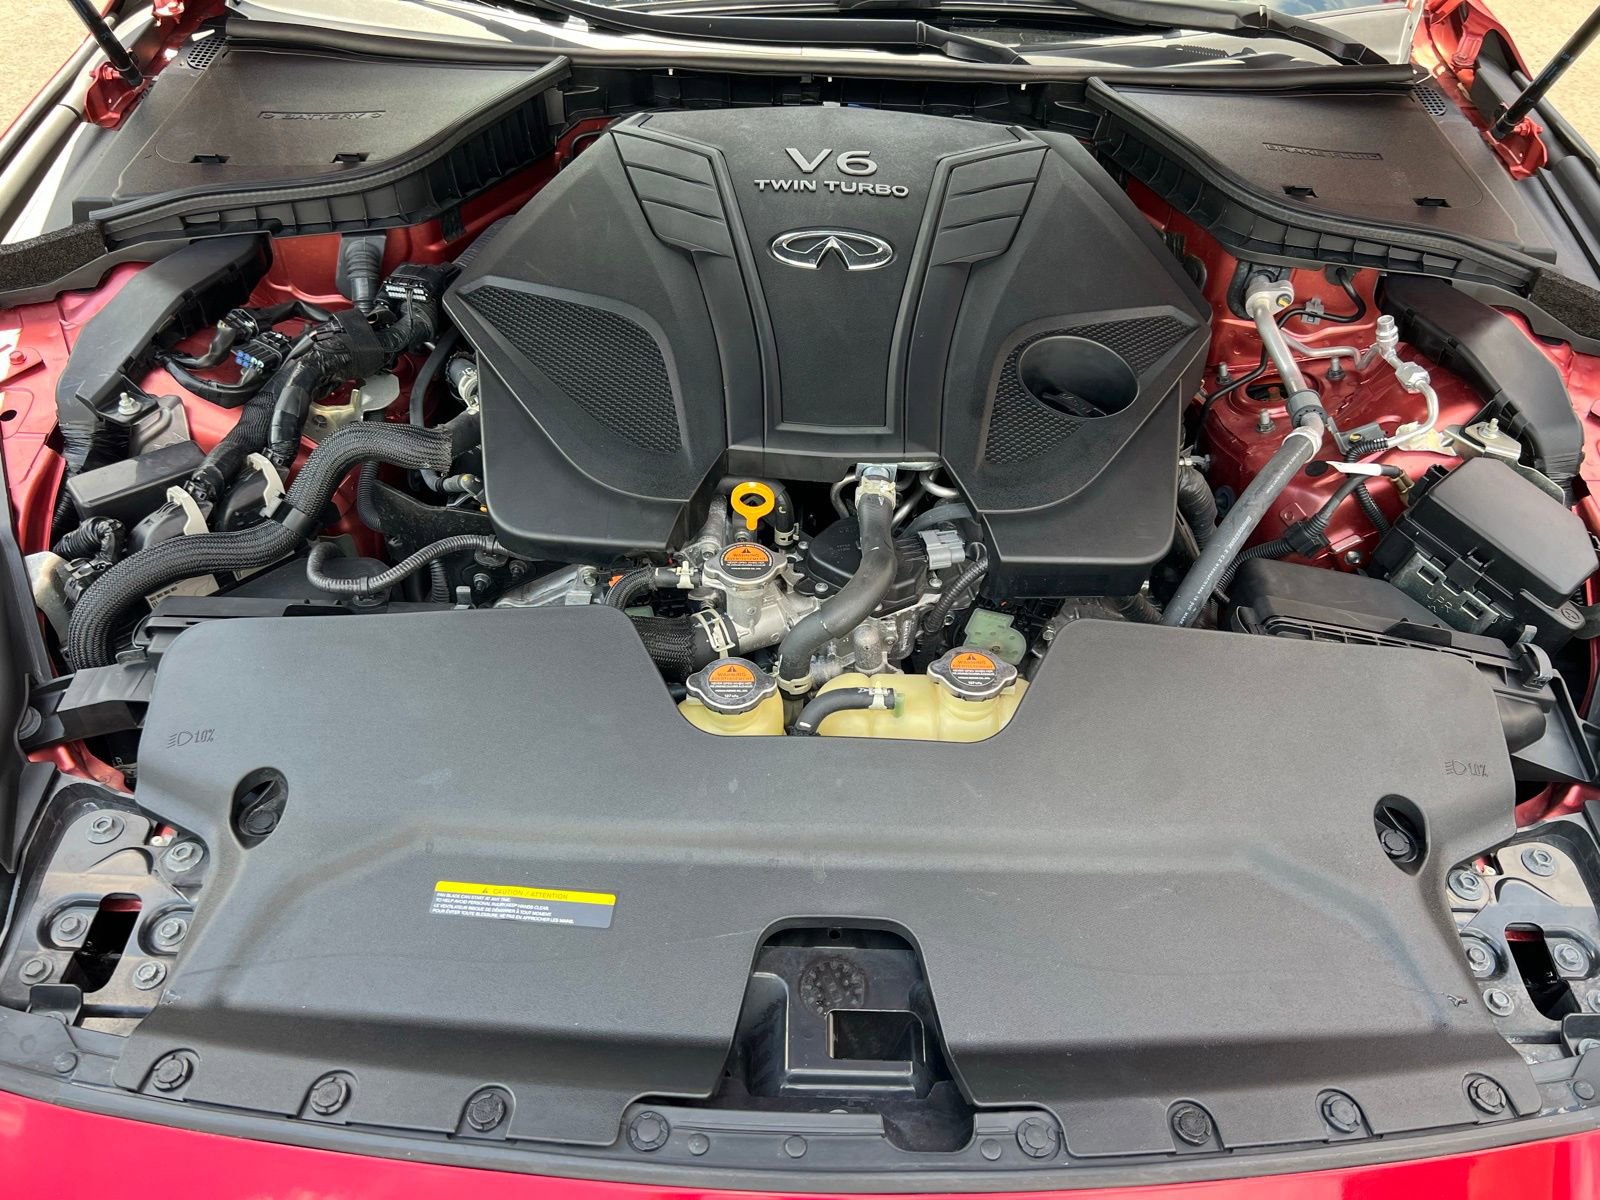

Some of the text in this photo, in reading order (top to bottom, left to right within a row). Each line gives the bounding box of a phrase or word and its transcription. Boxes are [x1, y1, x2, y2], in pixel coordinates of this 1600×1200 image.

[784, 147, 878, 176] V6
[754, 179, 910, 198] TWIN TURBO
